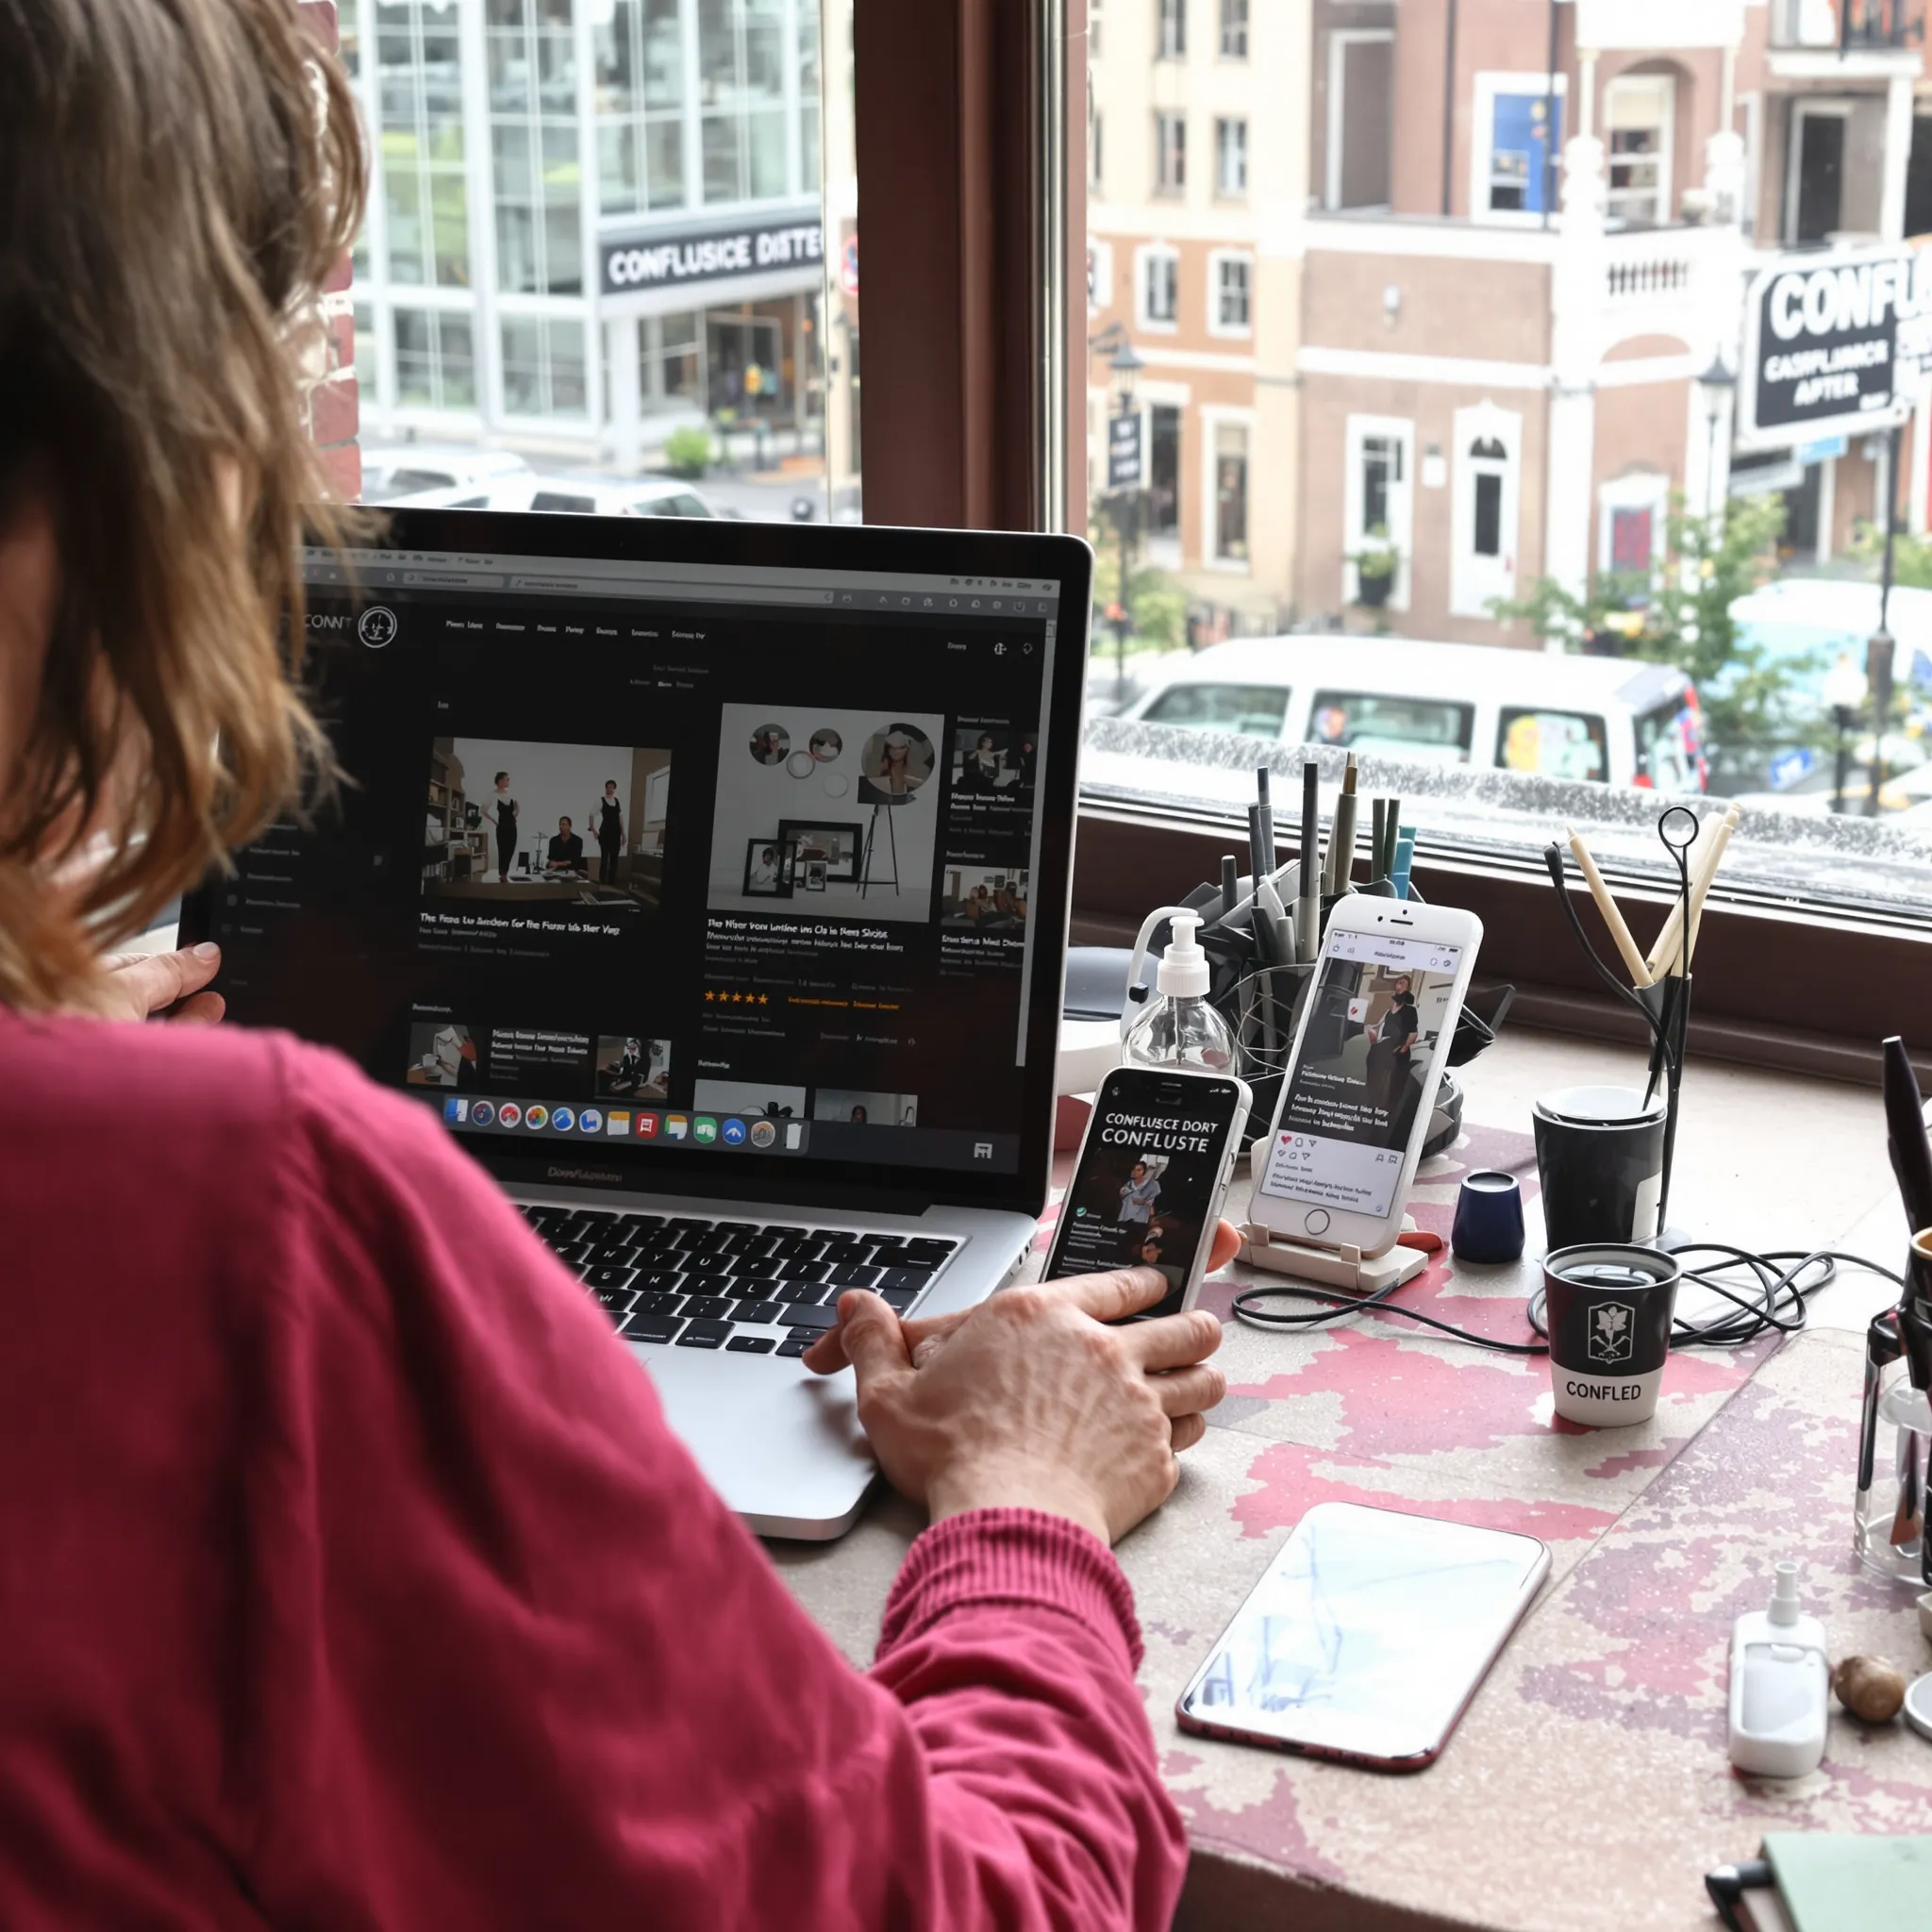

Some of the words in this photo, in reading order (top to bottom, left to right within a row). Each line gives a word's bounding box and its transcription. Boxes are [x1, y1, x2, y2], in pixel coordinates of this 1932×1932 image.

[1182, 1120, 1219, 1134] DORT
[1102, 1128, 1209, 1153] CONFLUSTE
[1566, 1381, 1641, 1401] CONFLED
